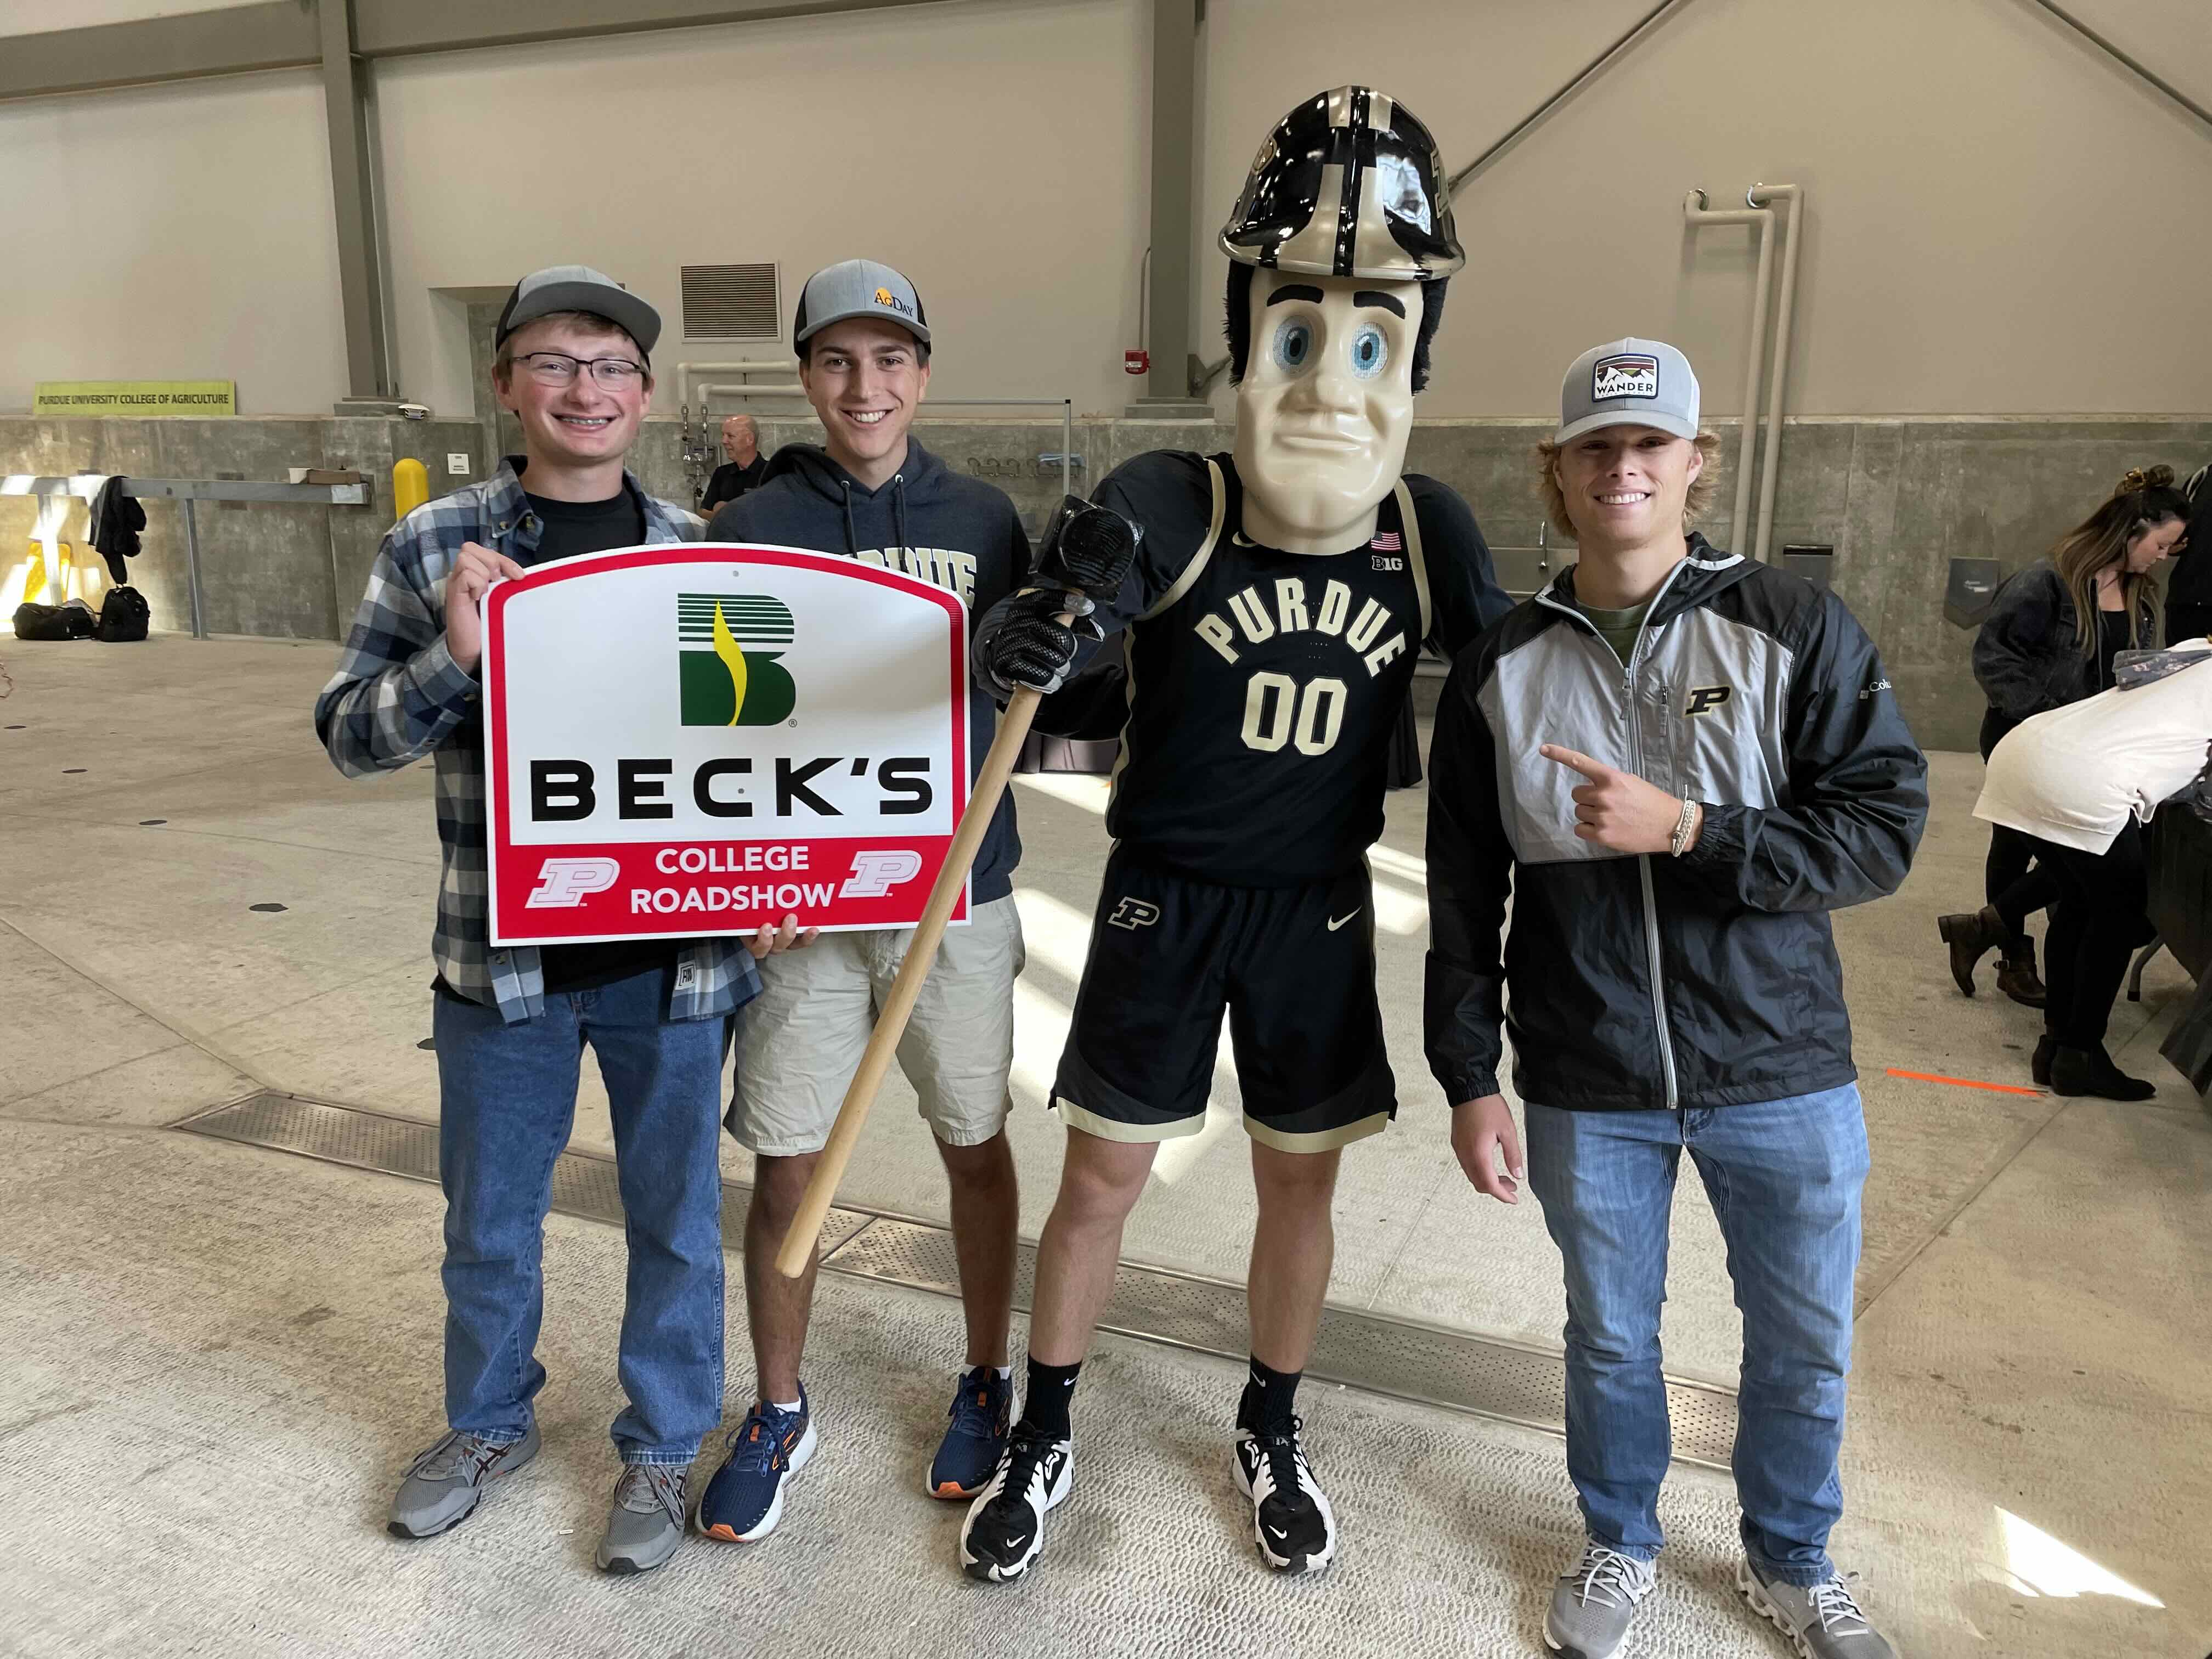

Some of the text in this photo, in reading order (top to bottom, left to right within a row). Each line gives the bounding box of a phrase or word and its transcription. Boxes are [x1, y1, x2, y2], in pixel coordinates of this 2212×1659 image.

[38, 393, 229, 405] PURDUE UNIVERSITY COLLEGE OF AGRICULTURE
[1596, 382, 1654, 394] WANDER
[1193, 578, 1406, 679] PURDUE
[1240, 670, 1350, 757] 00
[1685, 685, 1731, 716] P
[530, 758, 933, 822] BECK'S
[656, 846, 809, 874] COLLEGE
[838, 850, 922, 898] P
[524, 857, 620, 909] P
[631, 883, 835, 913] ROADSHOW
[1108, 896, 1160, 930] P
